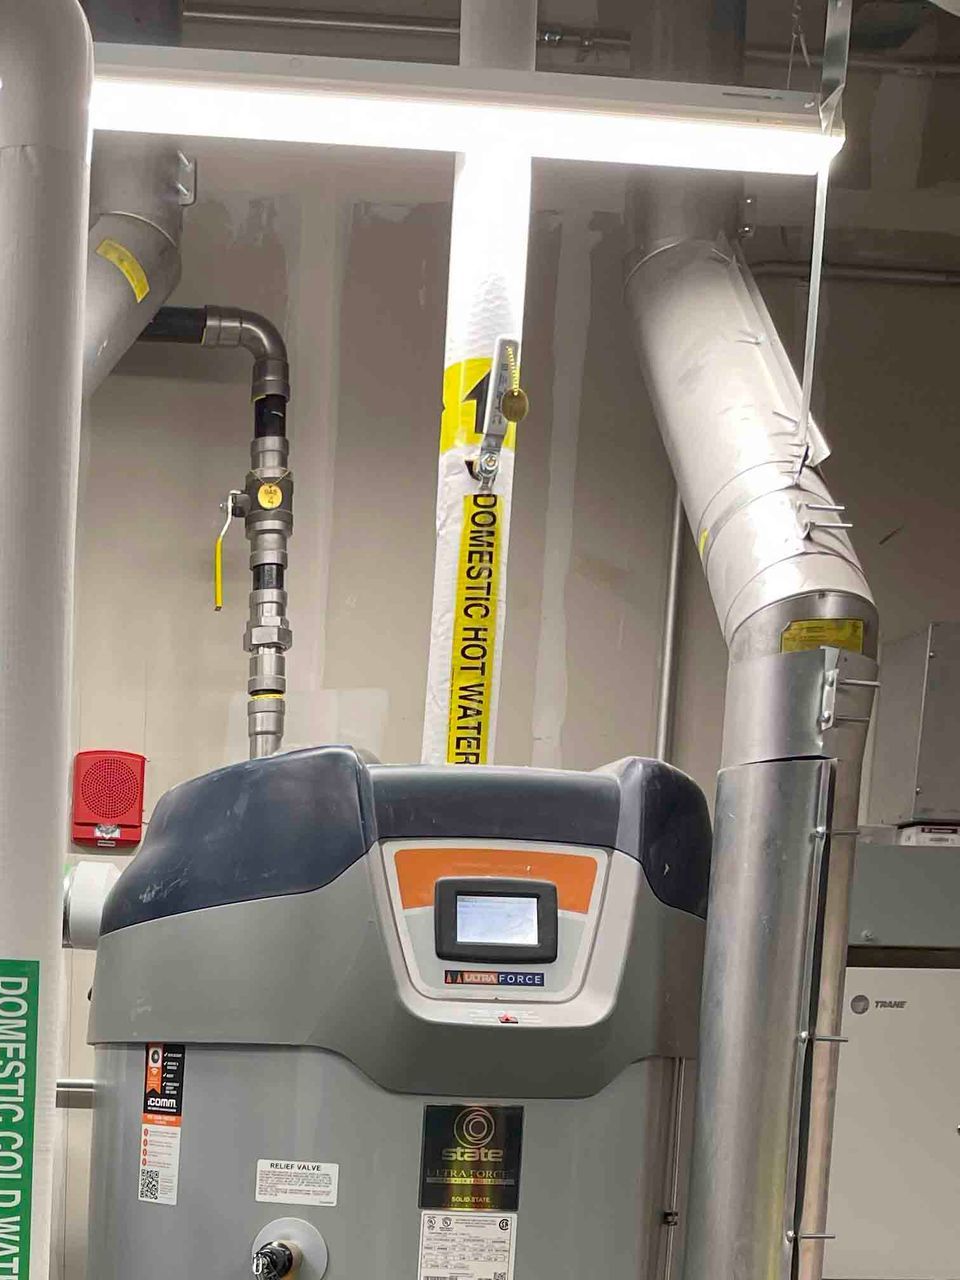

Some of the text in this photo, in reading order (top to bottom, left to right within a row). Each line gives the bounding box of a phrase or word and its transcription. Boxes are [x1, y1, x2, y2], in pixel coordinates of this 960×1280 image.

[454, 494, 497, 765] DOMESTIC HOT WATER
[464, 973, 541, 984] ULTRA FORCE
[874, 1001, 907, 1009] TRANE
[442, 1147, 503, 1162] state
[427, 1168, 509, 1178] ULTRA FORCE
